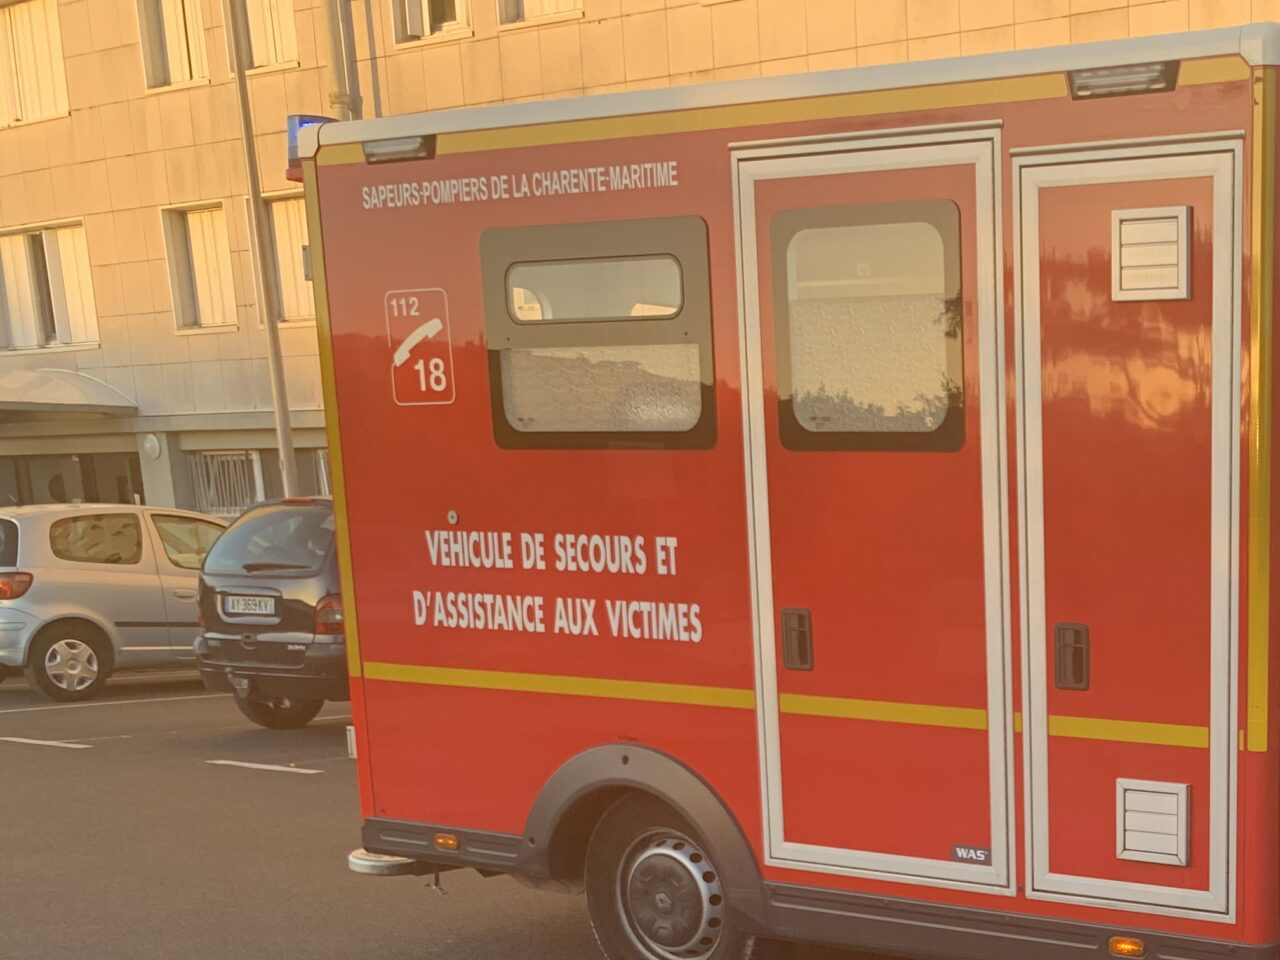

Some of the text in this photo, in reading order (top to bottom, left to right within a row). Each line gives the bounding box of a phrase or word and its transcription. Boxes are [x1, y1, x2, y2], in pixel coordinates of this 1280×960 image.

[362, 161, 679, 209] SAPEURS-POMPIERS DE LA CHARENTE-MARITIME
[390, 297, 420, 317] 112
[414, 357, 447, 392] 18
[425, 530, 678, 576] VEHICULE DE SECOURS ET
[412, 590, 703, 643] D'ASSISTANCE AUX VICTIMES
[956, 847, 986, 861] WAS
